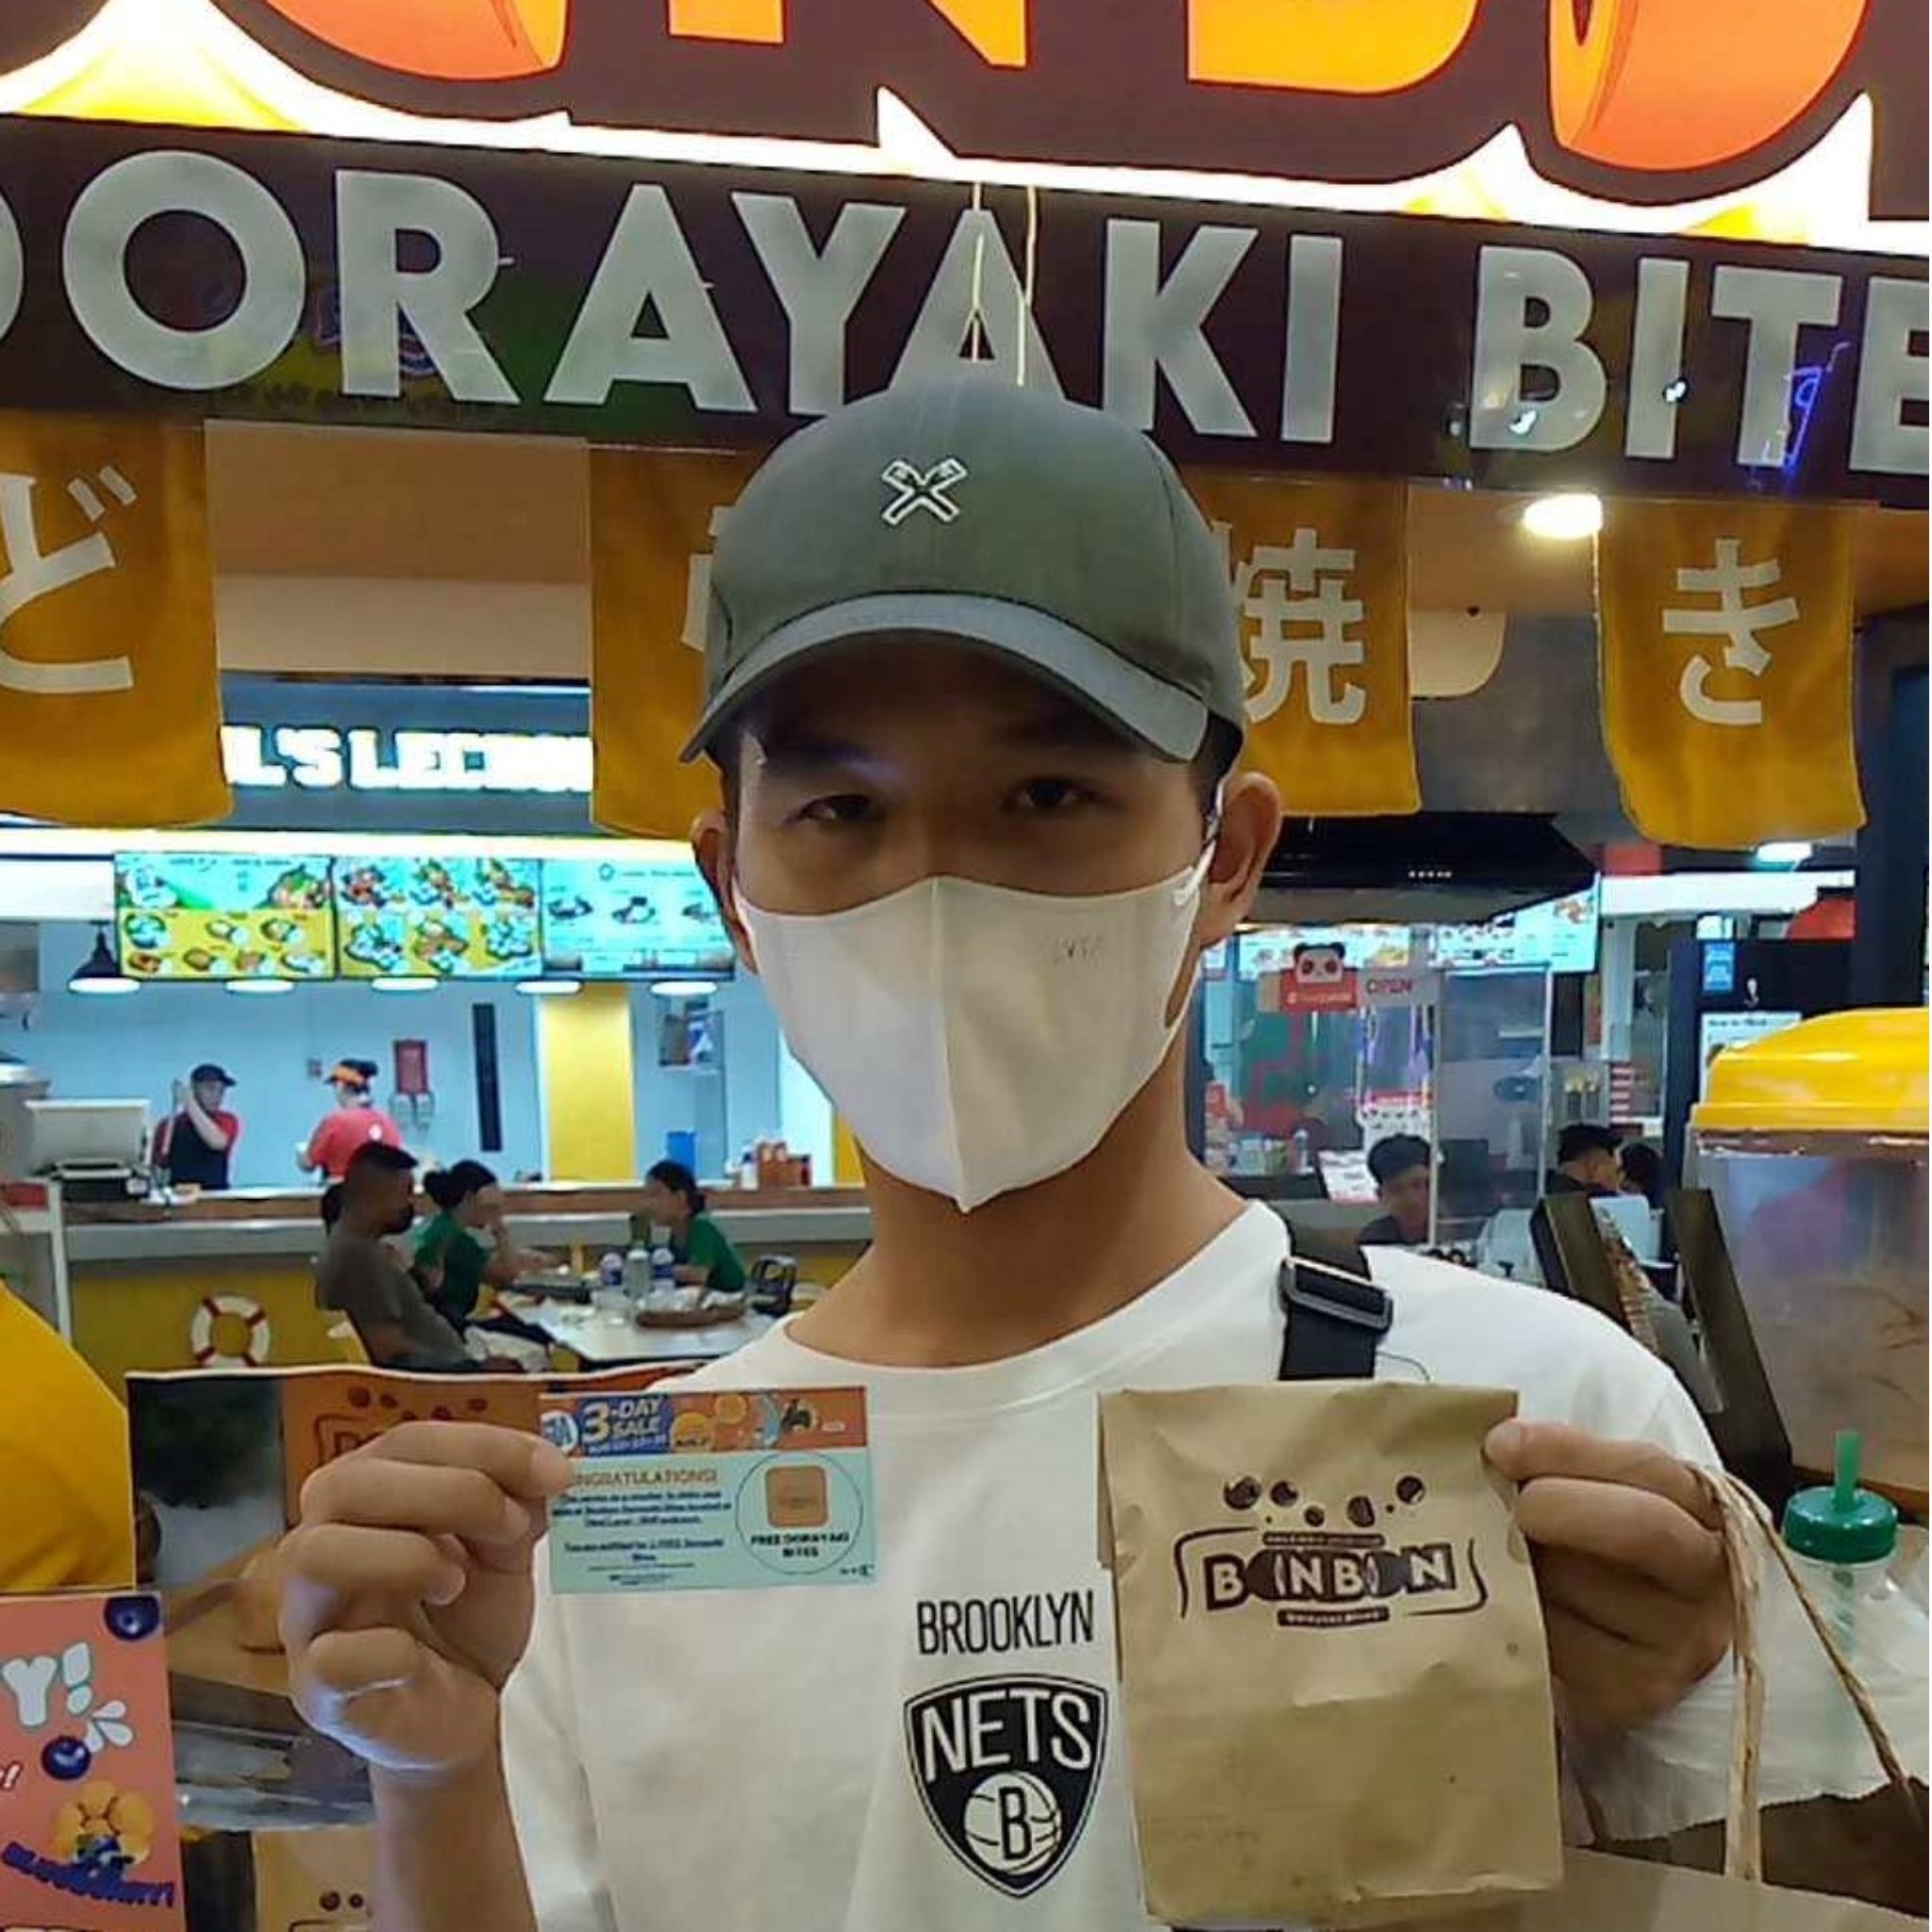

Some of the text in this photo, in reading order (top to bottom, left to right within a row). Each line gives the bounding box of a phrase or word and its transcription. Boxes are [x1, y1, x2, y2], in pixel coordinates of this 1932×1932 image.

[0, 150, 1343, 443] ORAYAKI
[0, 466, 138, 693] ど
[1662, 538, 1800, 726] き
[917, 1590, 1093, 1655] BROOKLYN
[922, 1687, 1091, 1783] NETS
[999, 1786, 1032, 1860] B
